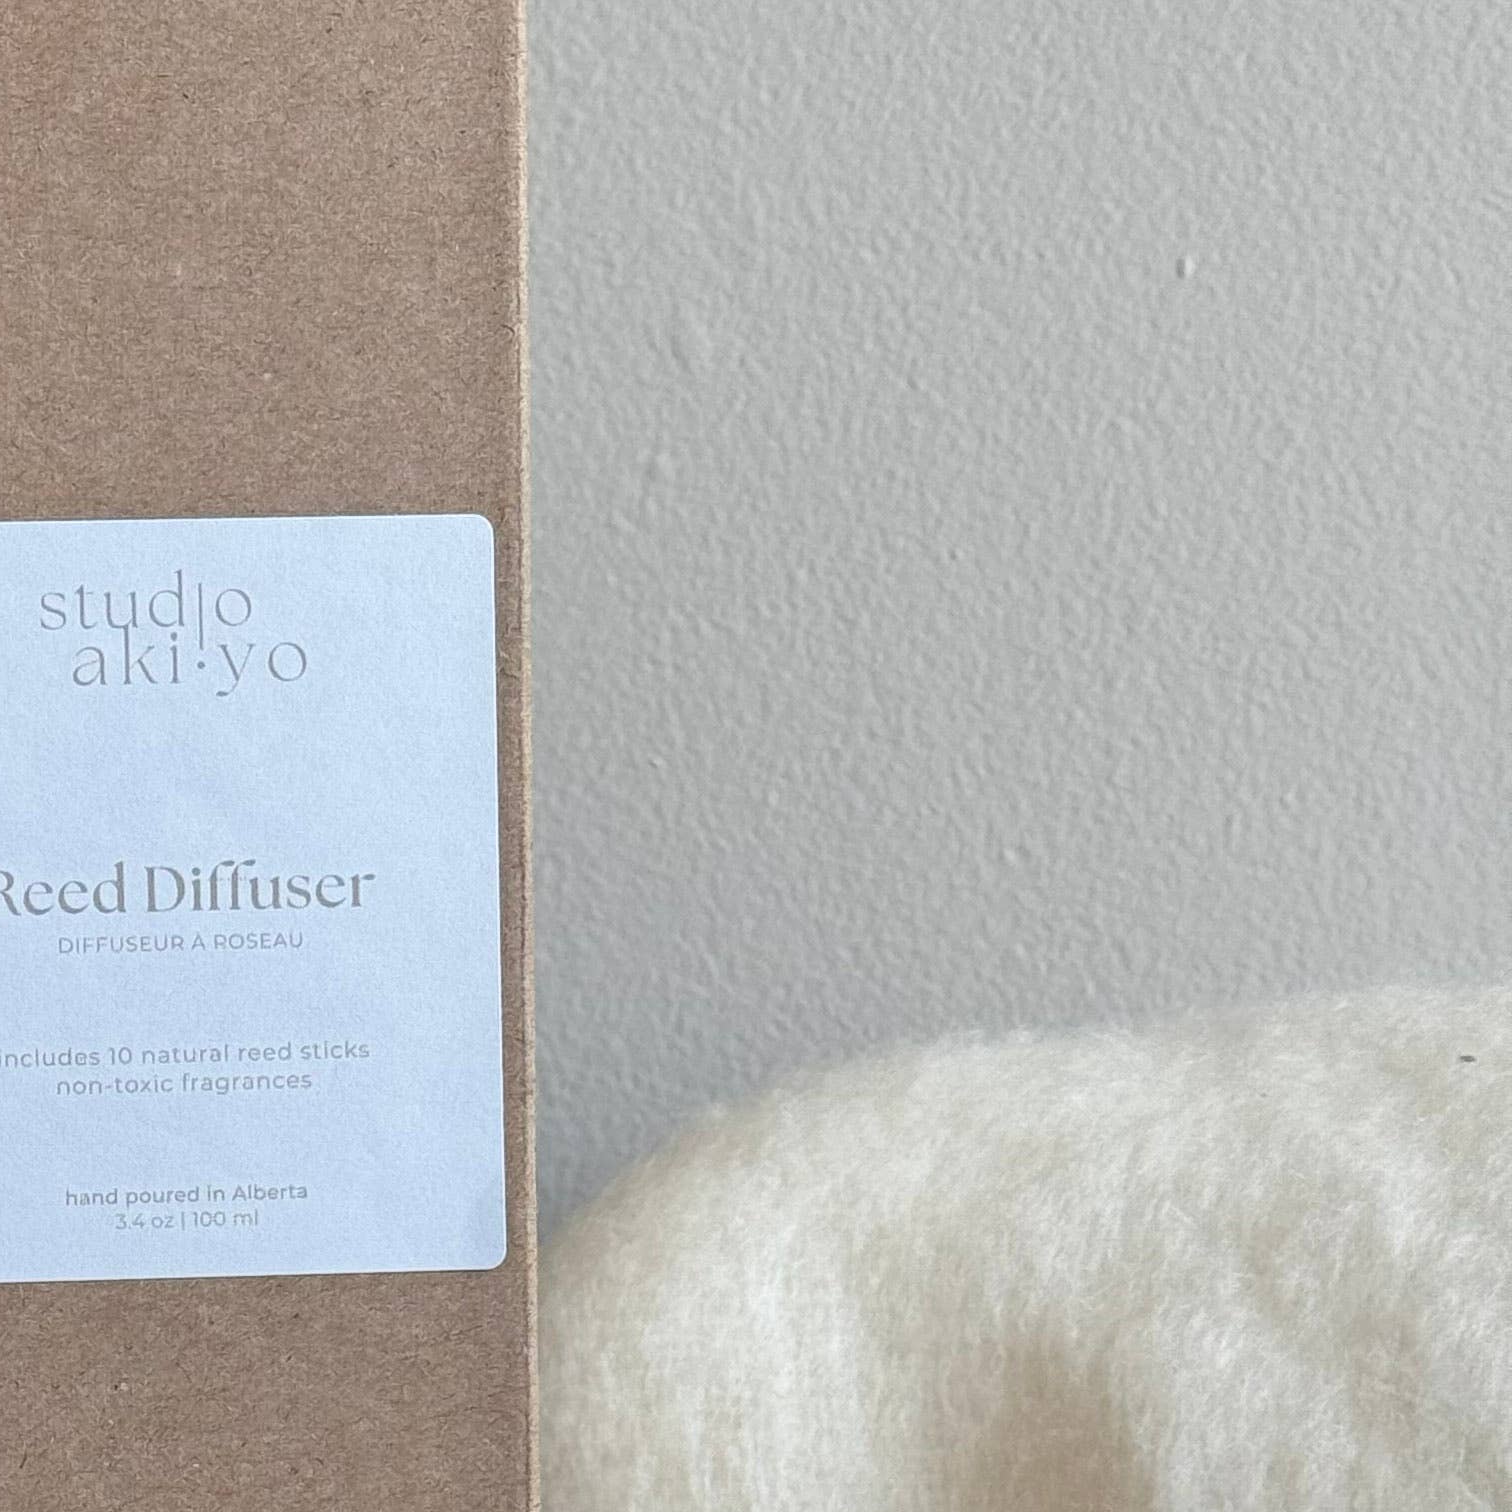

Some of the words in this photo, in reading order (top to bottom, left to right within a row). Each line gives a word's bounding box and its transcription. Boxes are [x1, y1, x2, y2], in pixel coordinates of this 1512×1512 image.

[145, 859, 375, 912] Diffuser
[59, 935, 184, 953] DIFFUSEUR
[214, 933, 302, 949] ROSEAU
[109, 1047, 132, 1065] 10
[142, 1044, 228, 1064] natural
[239, 1042, 291, 1061] reed
[301, 1041, 369, 1060] sticks
[57, 1078, 172, 1095] non-toxic
[183, 1073, 312, 1095] fragrances
[66, 1188, 117, 1205] hand
[126, 1186, 199, 1208] poured
[207, 1185, 225, 1201] in
[232, 1184, 307, 1200] Alberta
[116, 1214, 145, 1229] 3.4
[151, 1216, 173, 1228] oz
[193, 1211, 226, 1227] 100
[234, 1210, 258, 1225] ml
